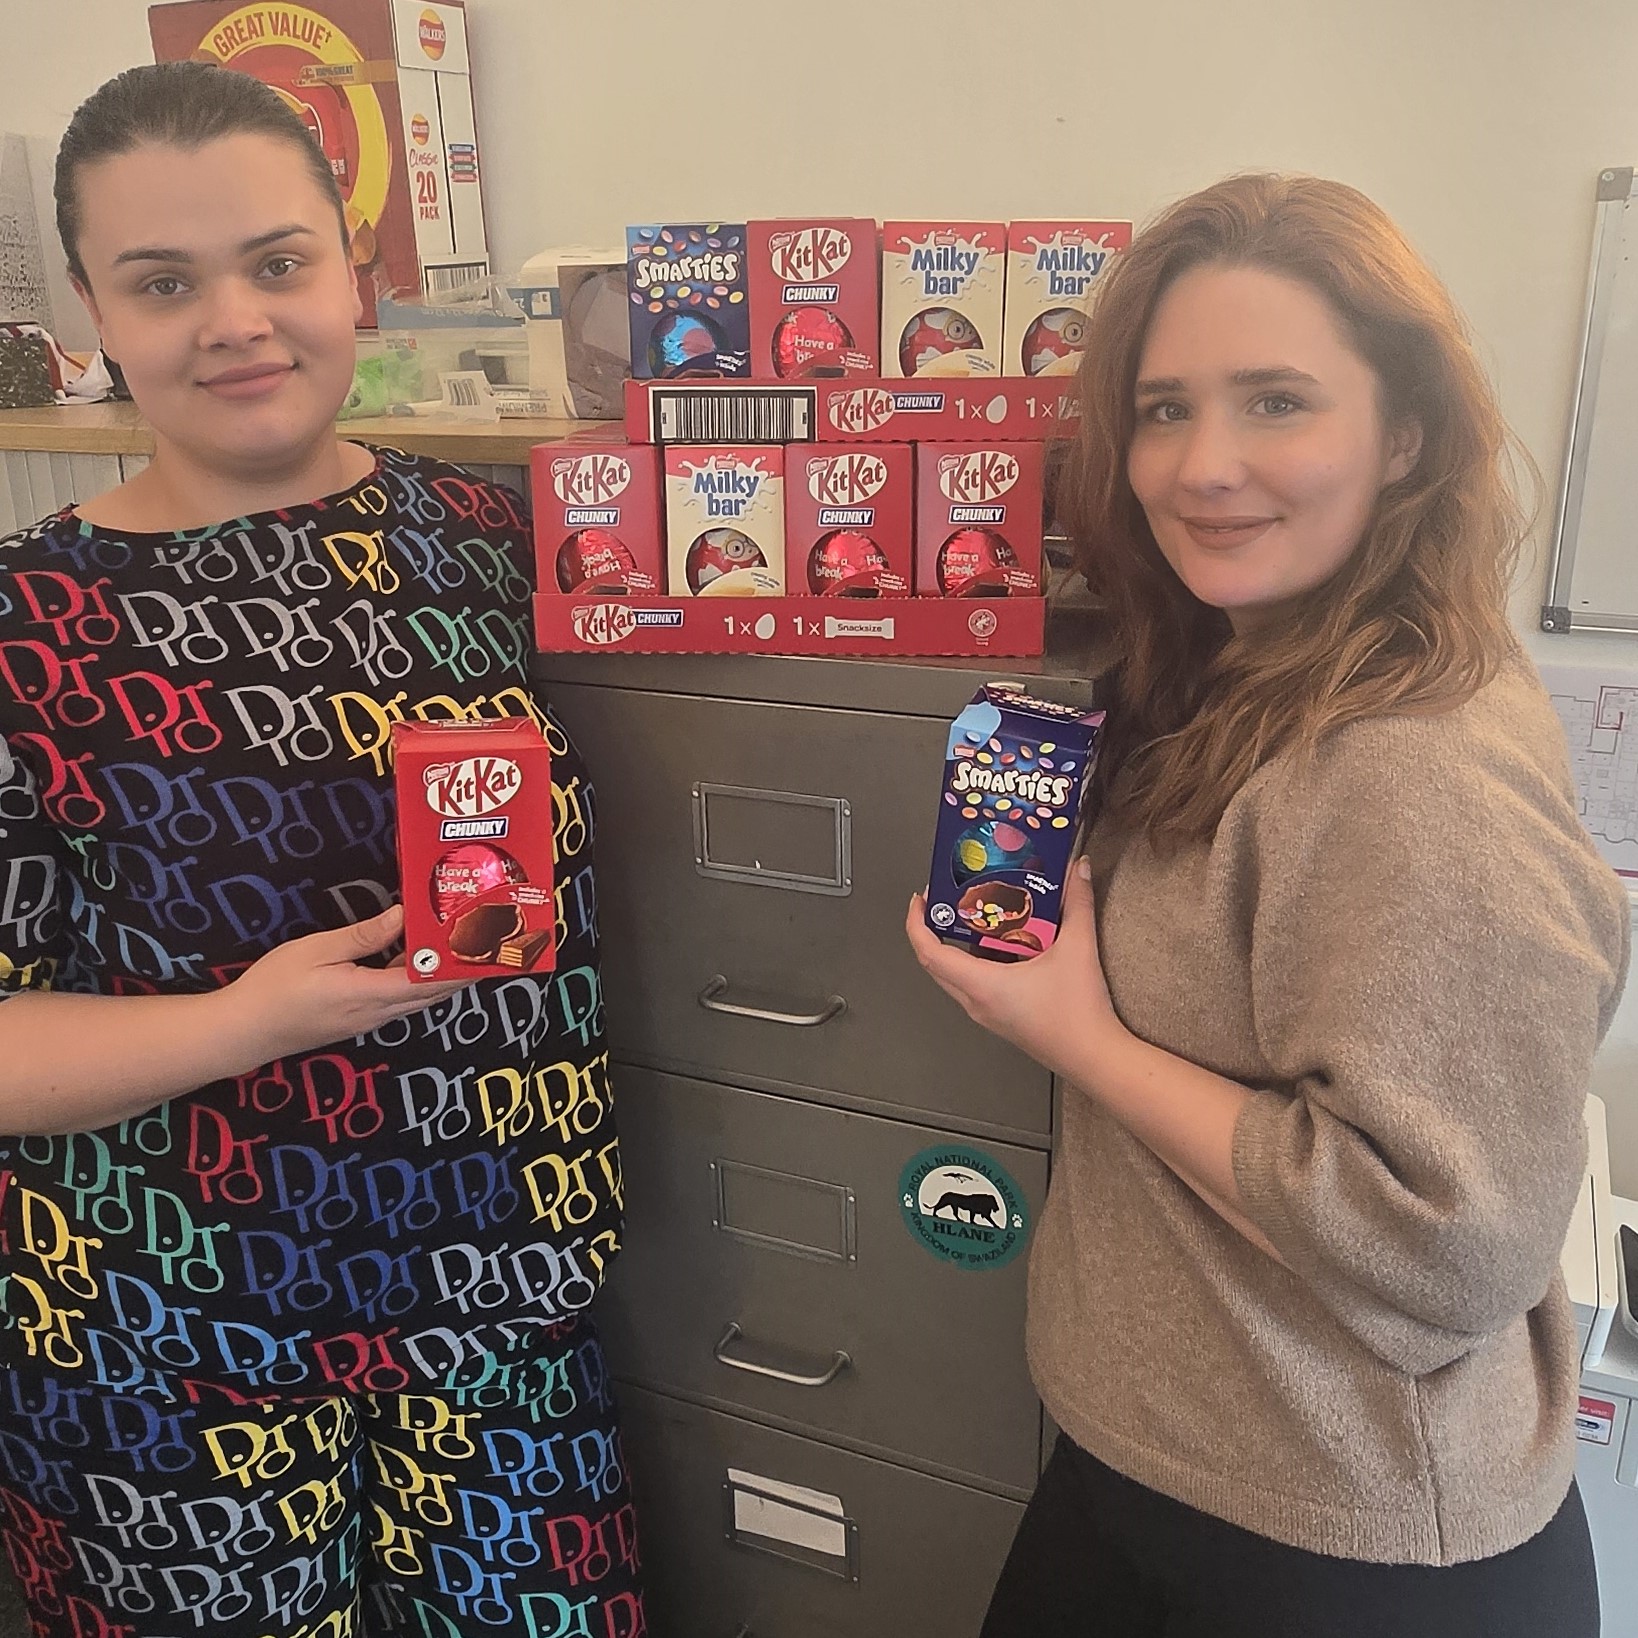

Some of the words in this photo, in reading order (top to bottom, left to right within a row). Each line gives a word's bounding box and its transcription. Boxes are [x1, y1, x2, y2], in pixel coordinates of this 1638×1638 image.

[213, 11, 265, 57] GREAT
[416, 170, 437, 203] 20
[420, 206, 440, 220] PACK
[911, 246, 979, 275] Milky
[1036, 246, 1106, 275] Milky
[925, 271, 964, 295] bar
[1050, 271, 1090, 295] bar
[786, 287, 836, 301] CHUNKY
[794, 336, 824, 349] Have
[897, 397, 941, 409] CHUNKY
[693, 471, 760, 498] Milky
[707, 493, 747, 516] bar
[953, 508, 1003, 521] CHUNKY
[568, 510, 617, 524] CHUNKY
[821, 510, 872, 524] CHUNKY
[637, 613, 681, 625] CHUNKY
[837, 623, 883, 633] Snacksize
[444, 820, 505, 838] CHUNKY
[435, 864, 470, 878] Have
[437, 879, 479, 894] break
[908, 1161, 934, 1192] ROYAL
[934, 1154, 994, 1178] NATIONAL
[995, 1177, 1018, 1211] PARK
[911, 1211, 950, 1254] KINGDOM
[951, 1250, 966, 1260] OF
[932, 1221, 995, 1244] HLANE
